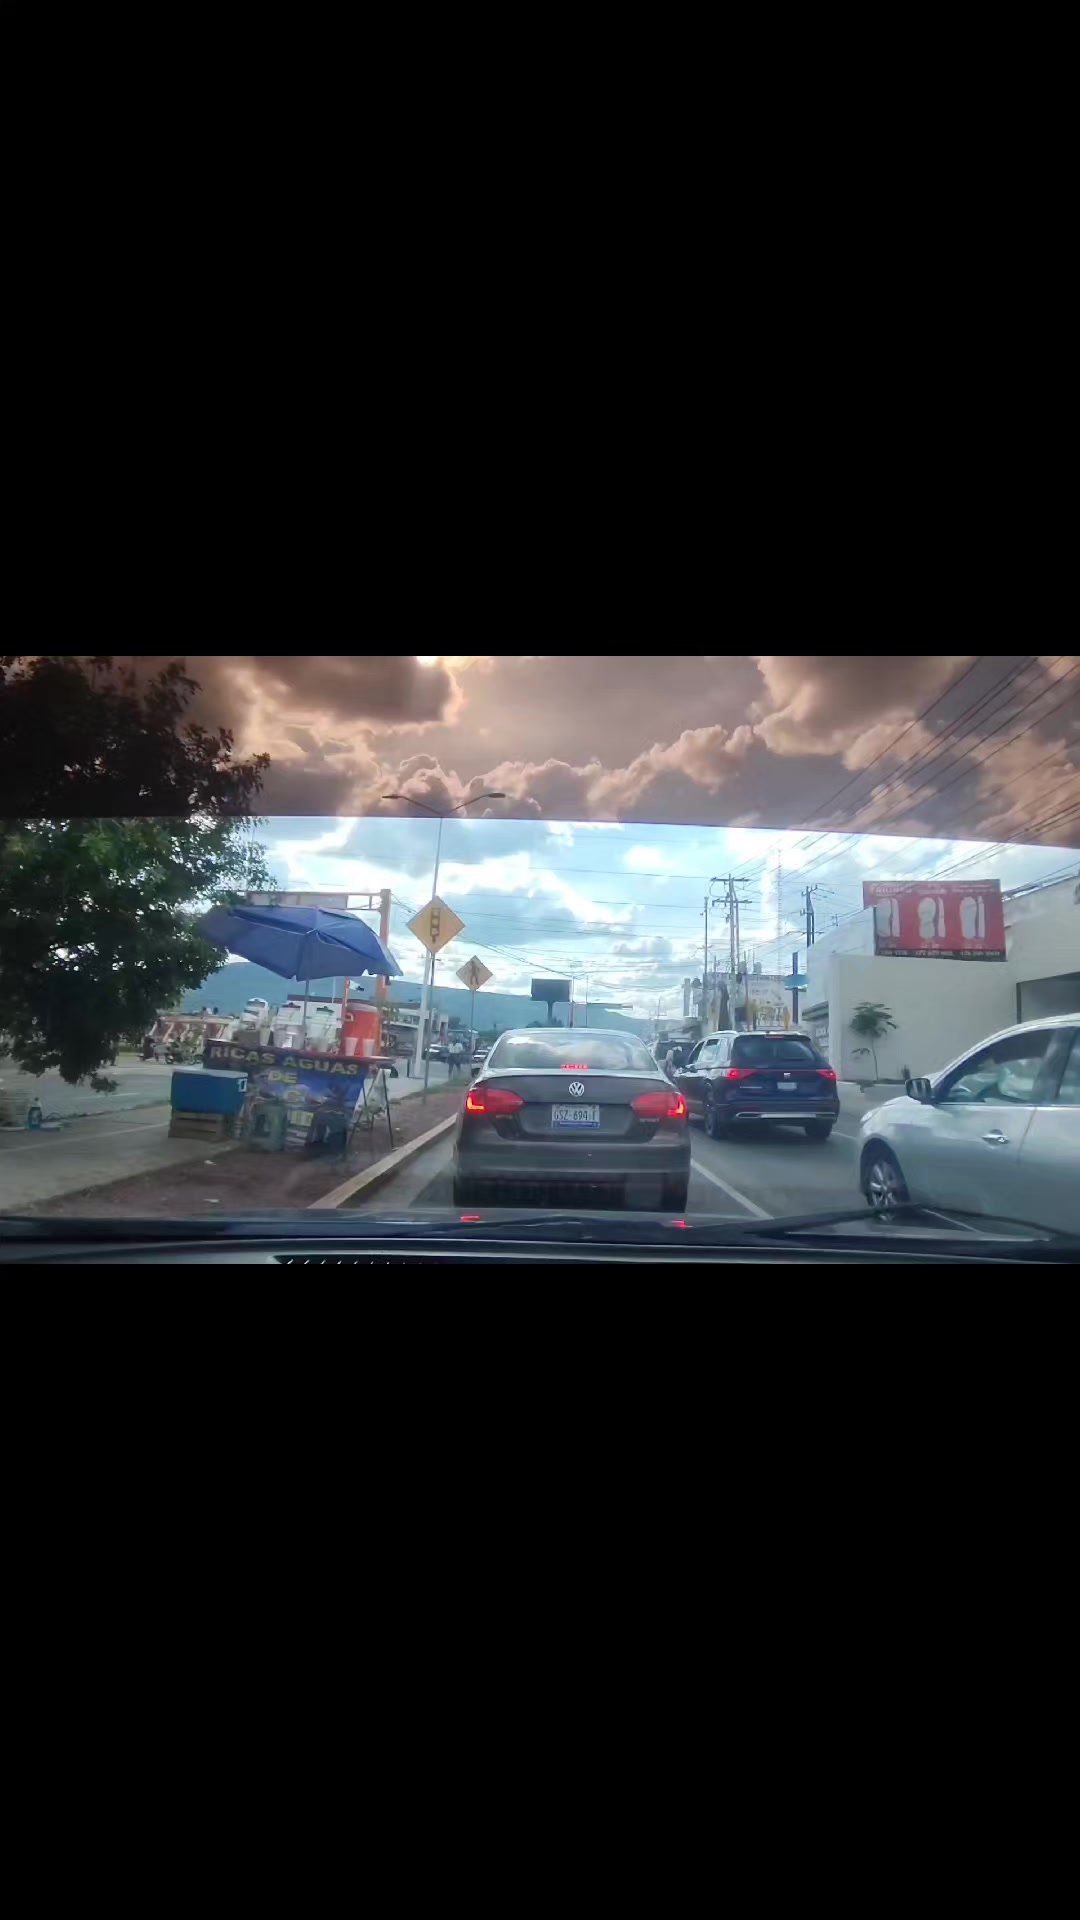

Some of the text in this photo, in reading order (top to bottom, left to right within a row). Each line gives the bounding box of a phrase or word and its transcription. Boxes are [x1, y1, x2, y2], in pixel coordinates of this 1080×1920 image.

[210, 1046, 359, 1075] RICAS AGUAS
[268, 1070, 297, 1084] DE
